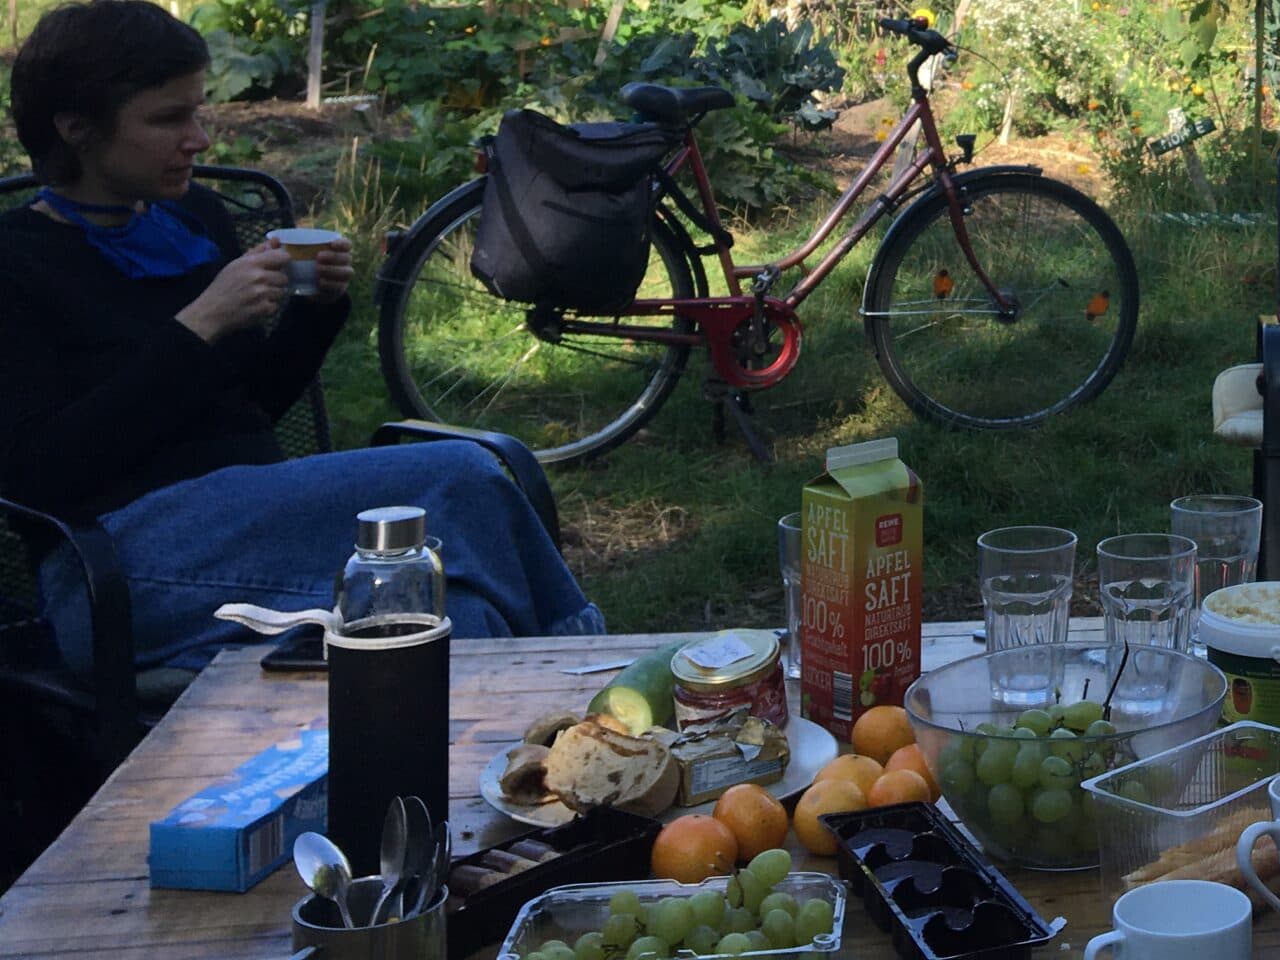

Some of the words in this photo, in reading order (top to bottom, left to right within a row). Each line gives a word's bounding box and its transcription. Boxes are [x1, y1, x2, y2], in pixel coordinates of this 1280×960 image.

[808, 502, 848, 533] APFEL
[879, 518, 899, 529] REWE
[808, 526, 848, 572] SAFT
[865, 550, 911, 579] APFEL
[865, 571, 911, 612] SAFT
